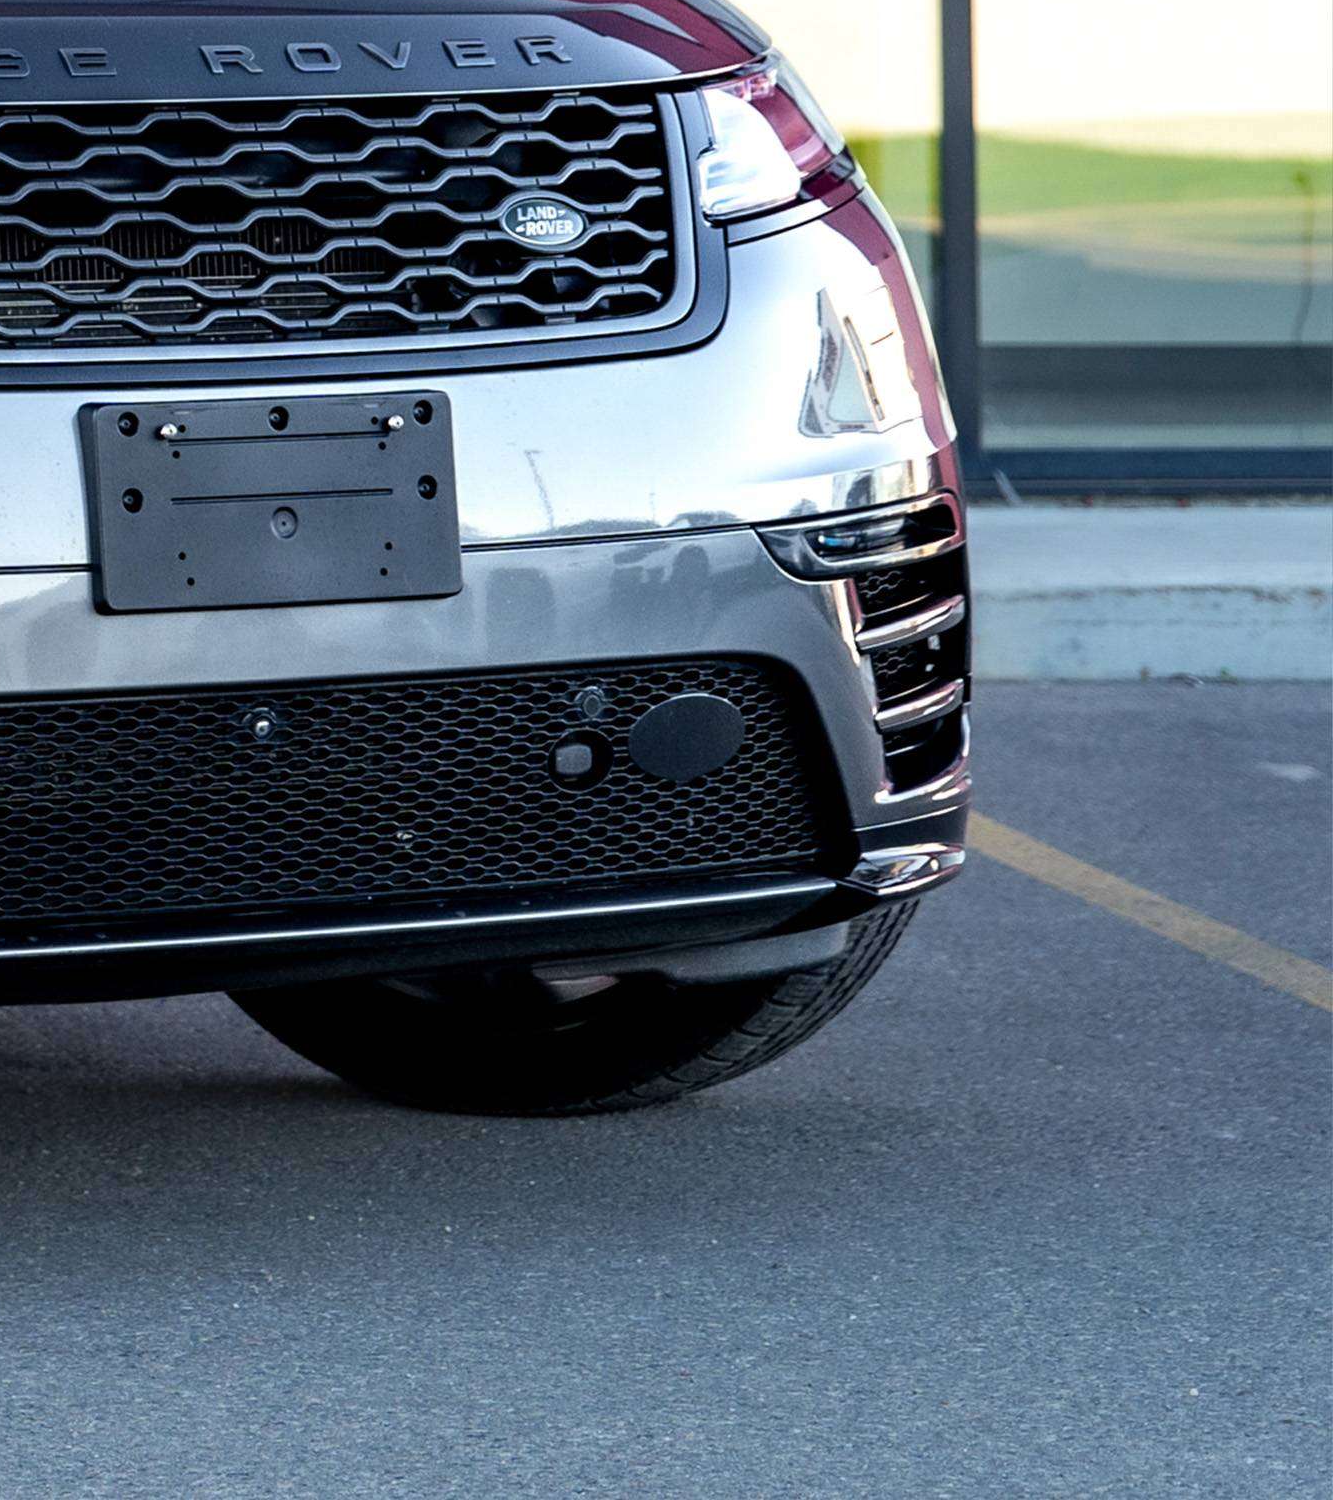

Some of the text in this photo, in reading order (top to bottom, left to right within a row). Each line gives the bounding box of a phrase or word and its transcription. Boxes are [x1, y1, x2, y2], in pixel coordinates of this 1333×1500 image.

[199, 35, 573, 74] ROVER
[516, 206, 558, 221] LAND
[525, 220, 575, 237] ROVER
